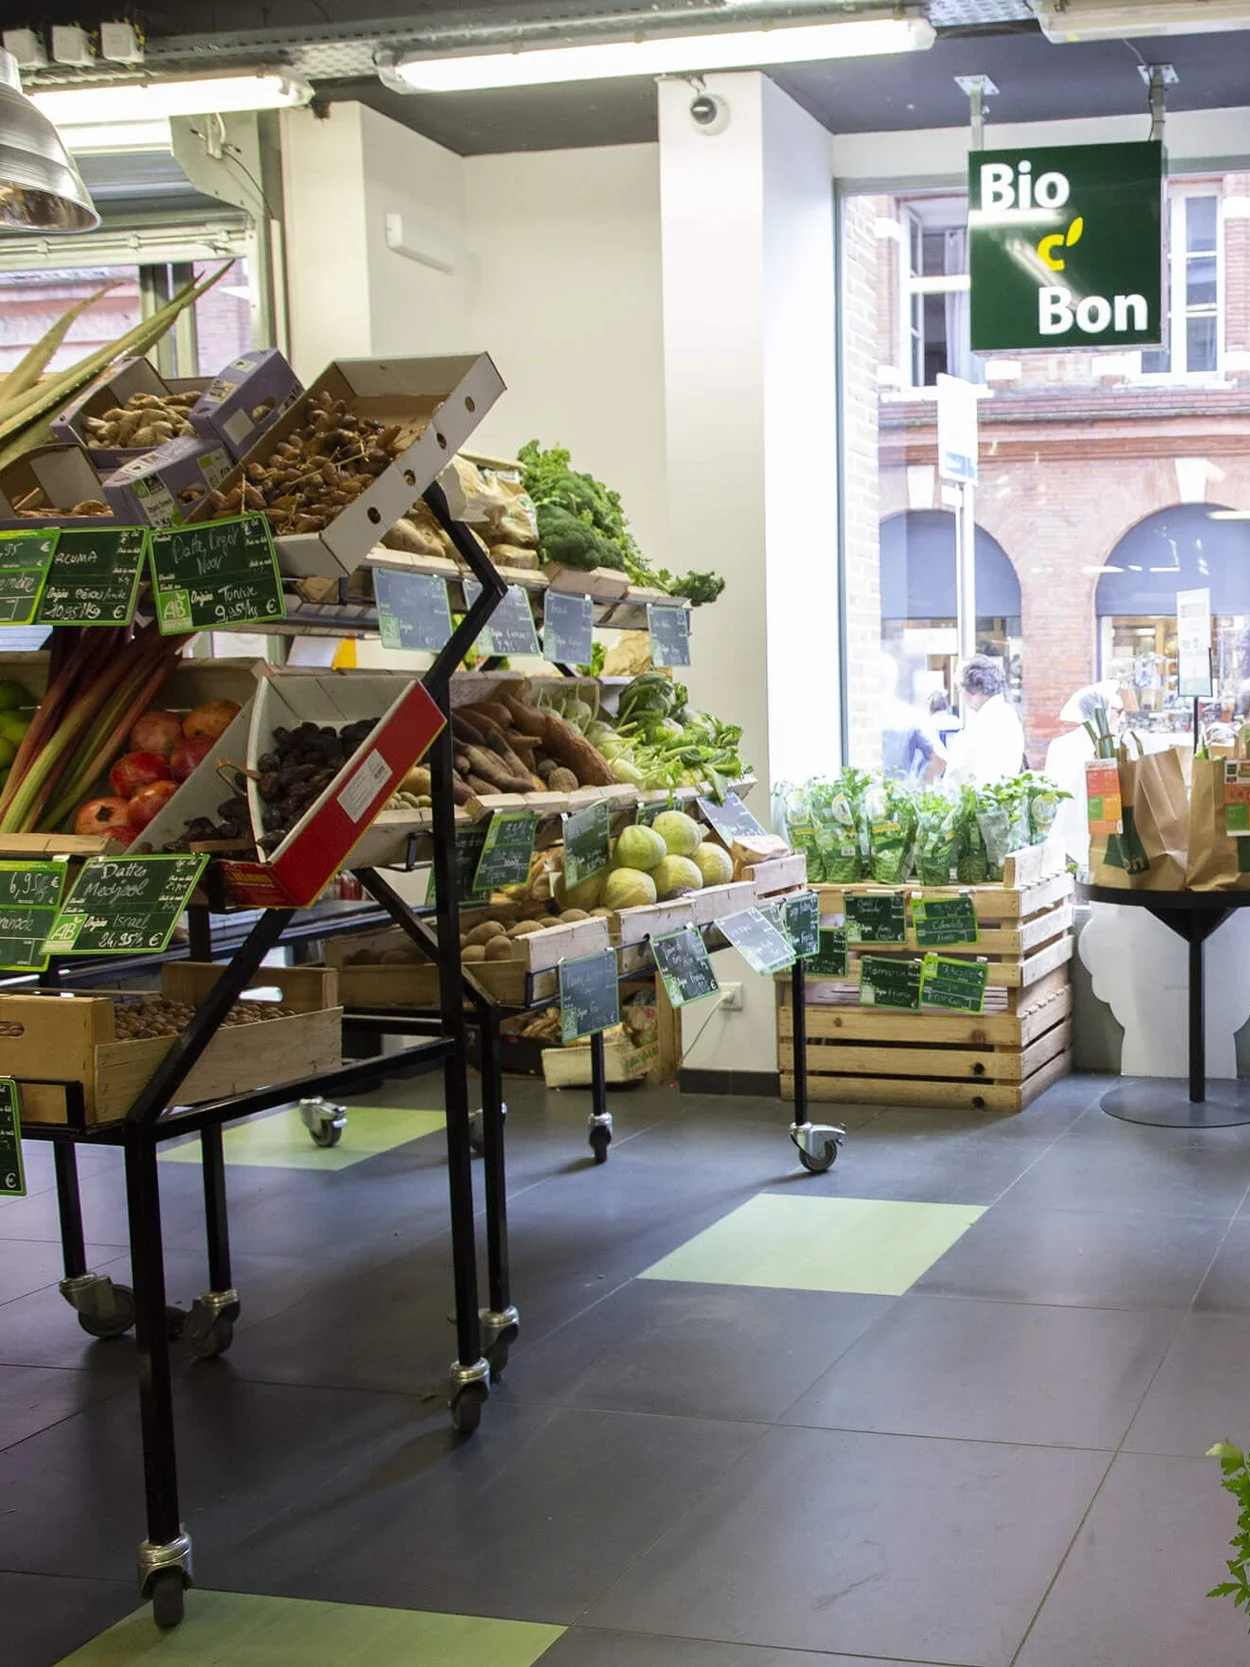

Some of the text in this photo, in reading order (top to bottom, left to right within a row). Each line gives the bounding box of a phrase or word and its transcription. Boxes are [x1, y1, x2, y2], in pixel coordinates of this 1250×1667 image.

[980, 160, 1070, 210] Bio
[1038, 286, 1149, 335] Bon
[112, 604, 126, 620] €
[266, 599, 279, 614] €
[50, 923, 77, 941] AB
[148, 932, 164, 947] €
[5, 1172, 17, 1188] €
